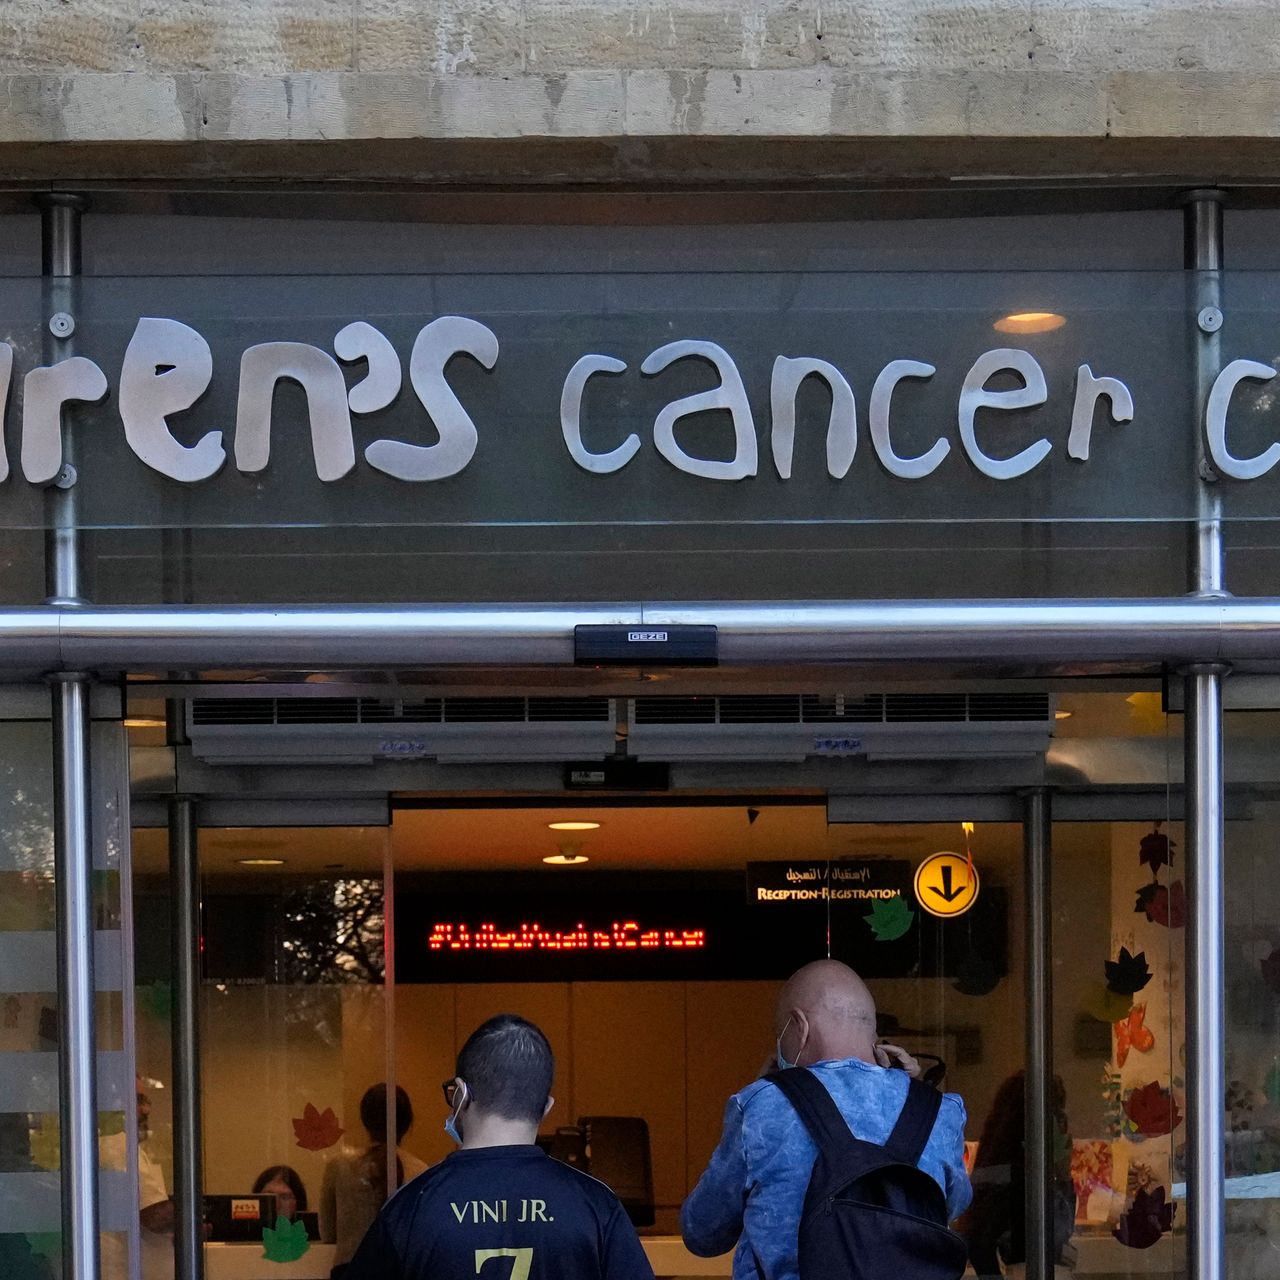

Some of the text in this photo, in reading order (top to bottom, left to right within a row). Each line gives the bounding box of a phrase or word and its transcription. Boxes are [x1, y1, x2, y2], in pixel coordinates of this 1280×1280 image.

[560, 340, 1133, 480] cancer
[450, 1199, 555, 1224] VINI JR.
